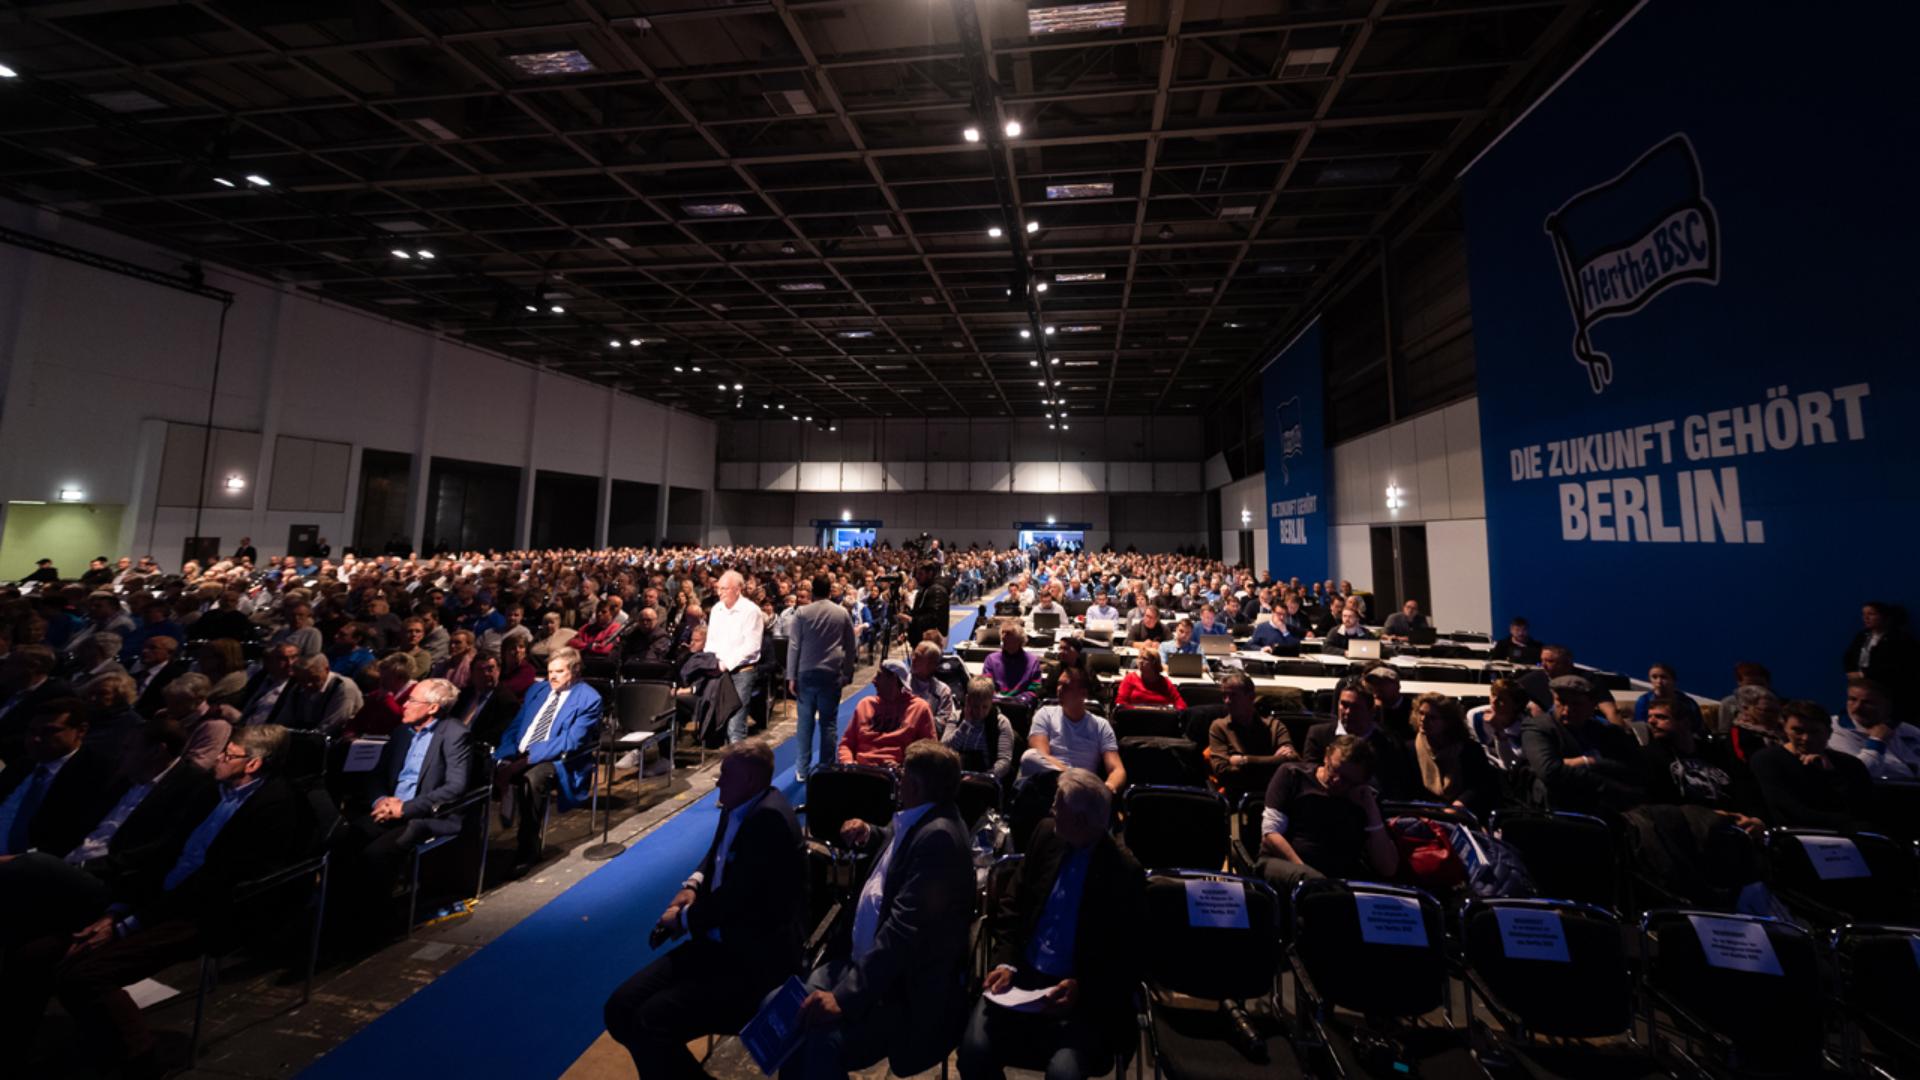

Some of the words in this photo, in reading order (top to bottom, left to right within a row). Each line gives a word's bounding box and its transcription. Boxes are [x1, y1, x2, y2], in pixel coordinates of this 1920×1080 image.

[1510, 445, 1542, 480] DIE
[1548, 421, 1676, 477] ZUKUNFT
[1683, 384, 1870, 460] GEHÖRT
[1559, 467, 1764, 543] BERLIN.
